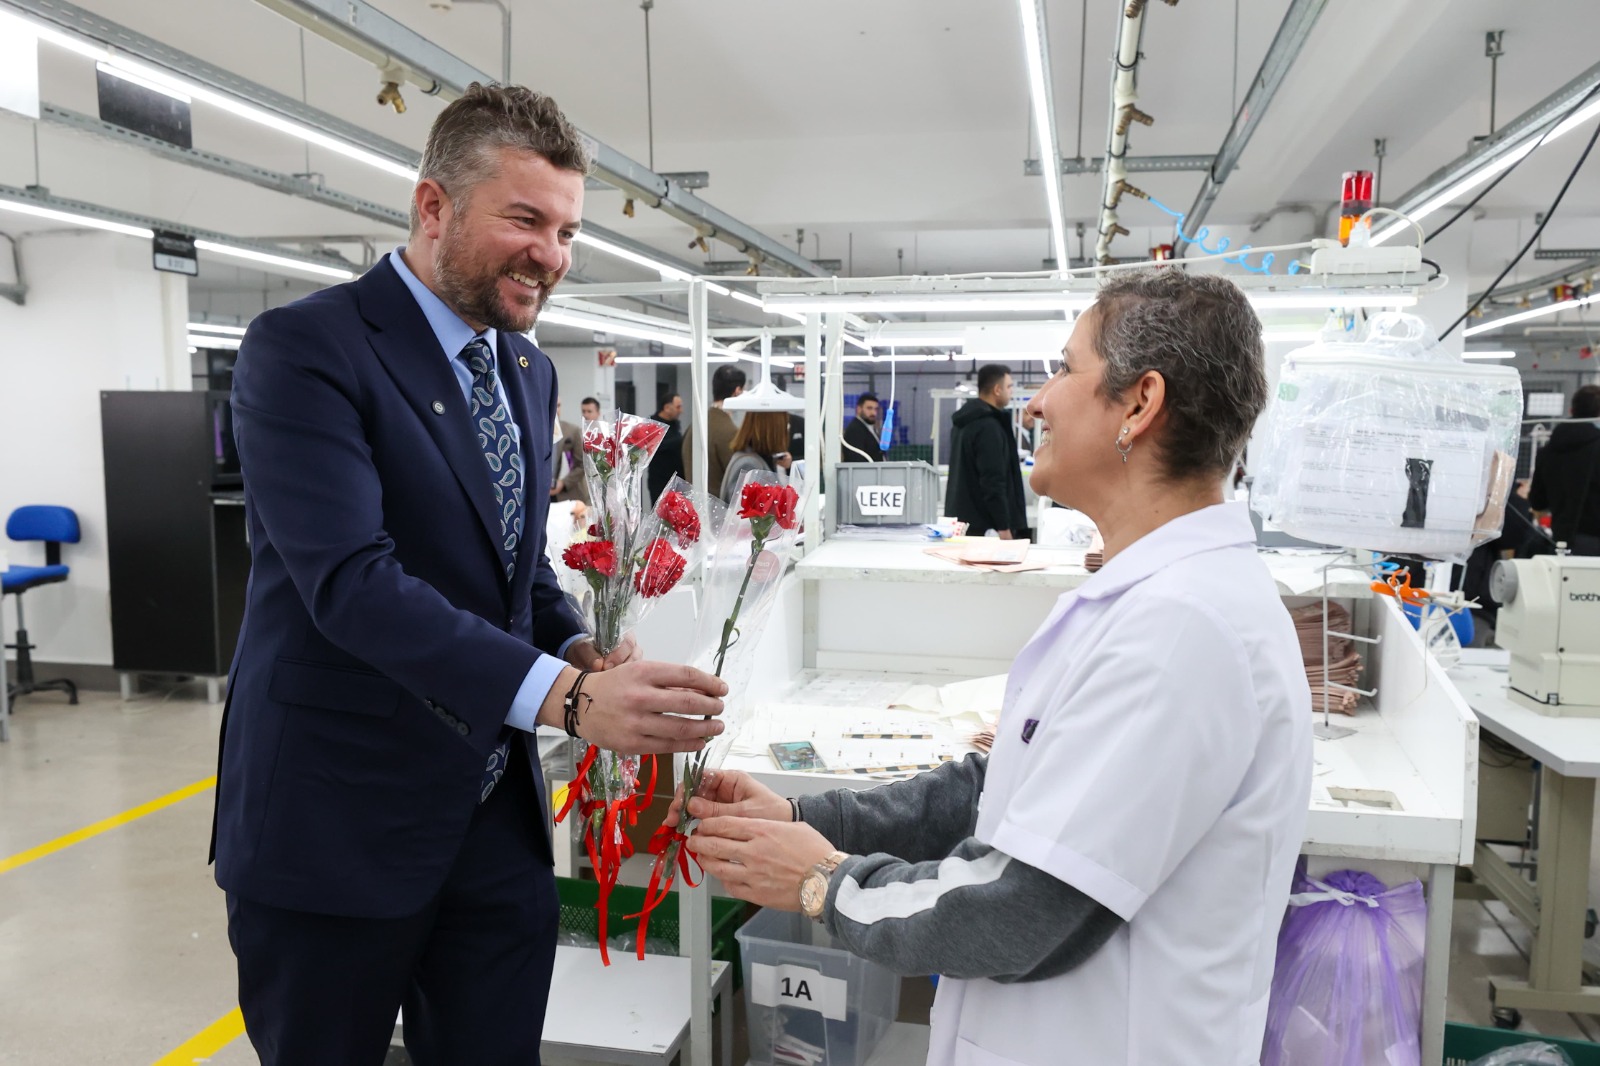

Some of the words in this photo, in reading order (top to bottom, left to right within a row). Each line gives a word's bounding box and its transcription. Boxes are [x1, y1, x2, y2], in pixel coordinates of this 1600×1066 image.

[860, 491, 902, 507] LEKE
[1569, 592, 1600, 602] broth
[781, 977, 813, 1001] 1A
